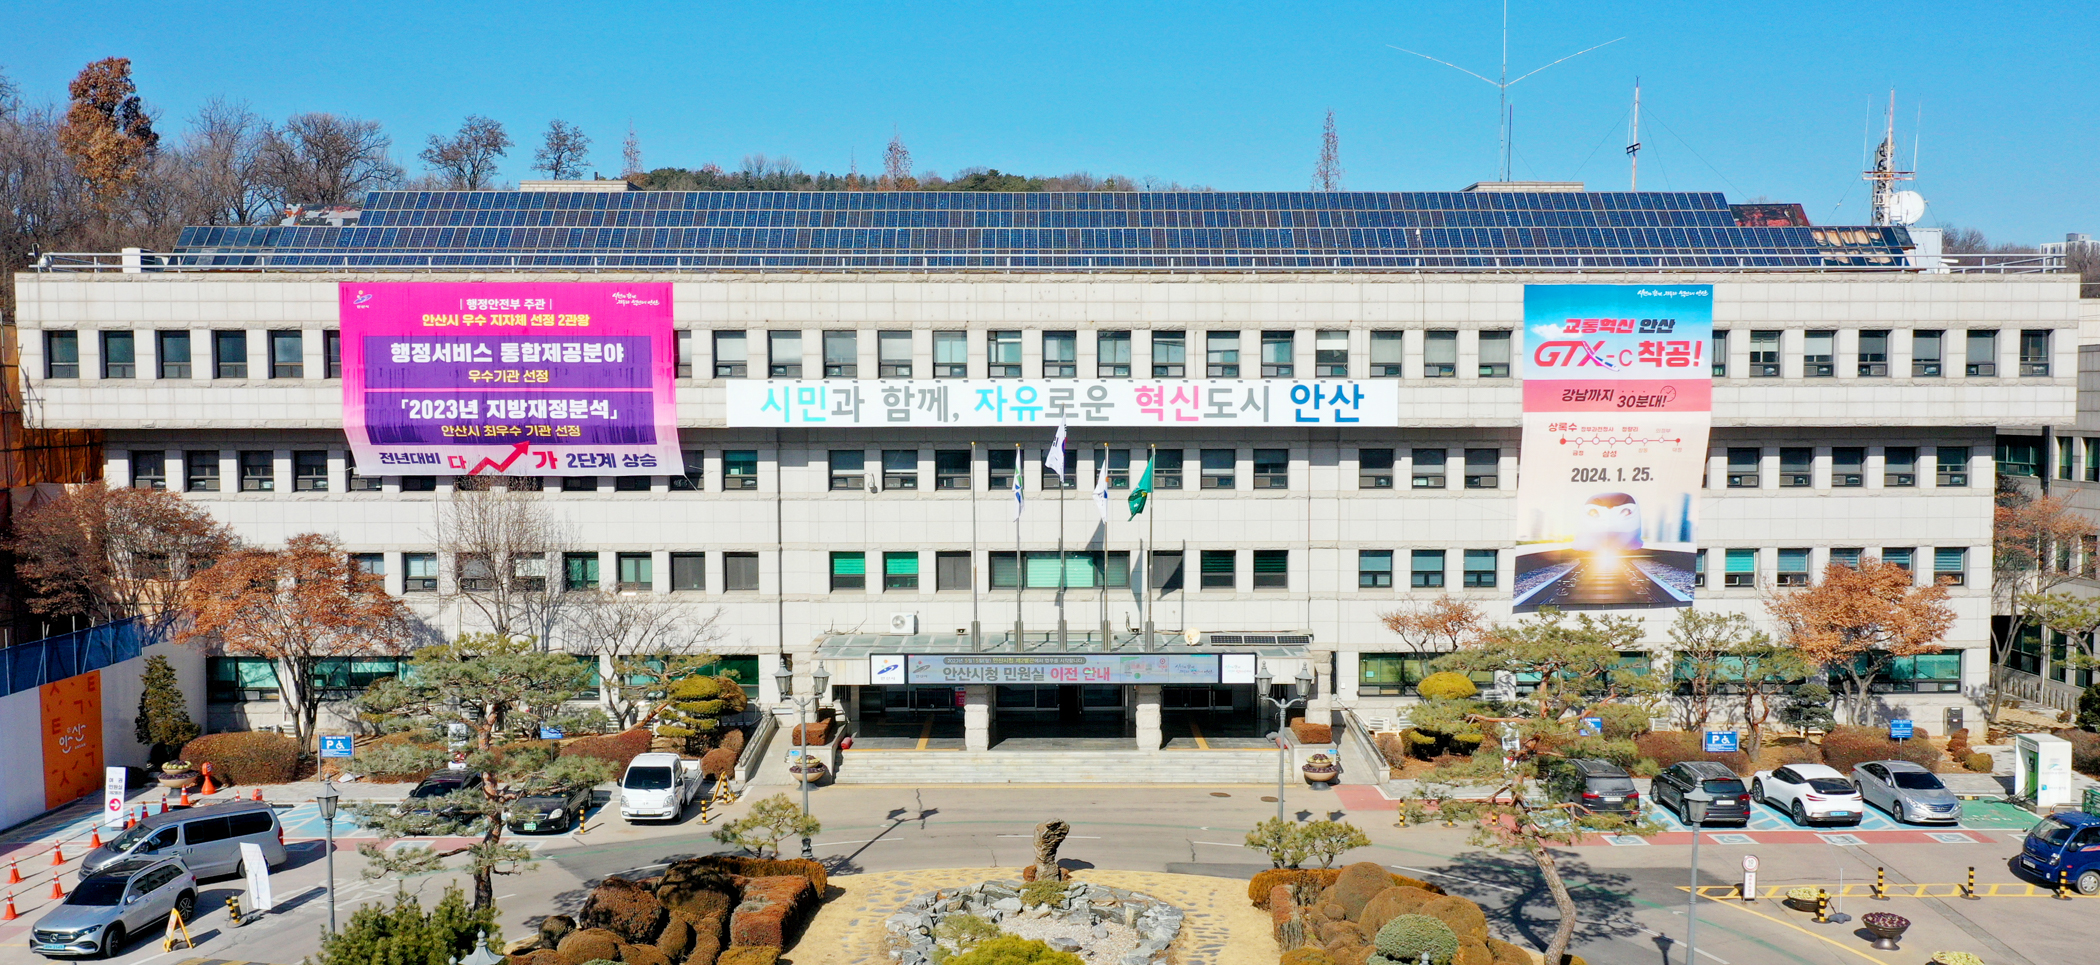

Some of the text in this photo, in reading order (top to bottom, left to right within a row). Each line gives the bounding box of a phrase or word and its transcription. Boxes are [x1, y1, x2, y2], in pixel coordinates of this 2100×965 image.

[467, 299, 546, 310] 행정안전부 주관
[422, 314, 591, 326] 안산시 우수 지자체 선정 2관왕
[1562, 318, 1676, 334] 교통혁신 안산
[391, 343, 625, 363] 행정서비스 통합제공분야
[1638, 340, 1702, 368] 착공!
[469, 369, 549, 383] 우수기관 선정
[761, 384, 1365, 423] 시민과 함께, 자유로운 혁신도시 안산
[1562, 389, 1667, 408] 강남까지 30분대!
[402, 399, 618, 420] 「2023년 지방재정분석」
[442, 425, 581, 437] 안산시 최우수 기관 선정
[1549, 423, 1577, 432] 상록수
[379, 451, 658, 470] 전년대비 다 가 2단계 상승
[1602, 449, 1617, 458] 삼성
[1571, 467, 1654, 482] 2024. 1. 25.
[943, 667, 998, 682] 안산시청
[1004, 667, 1045, 682] 민원실
[1050, 667, 1078, 682] 이전
[1083, 667, 1110, 682] 안내
